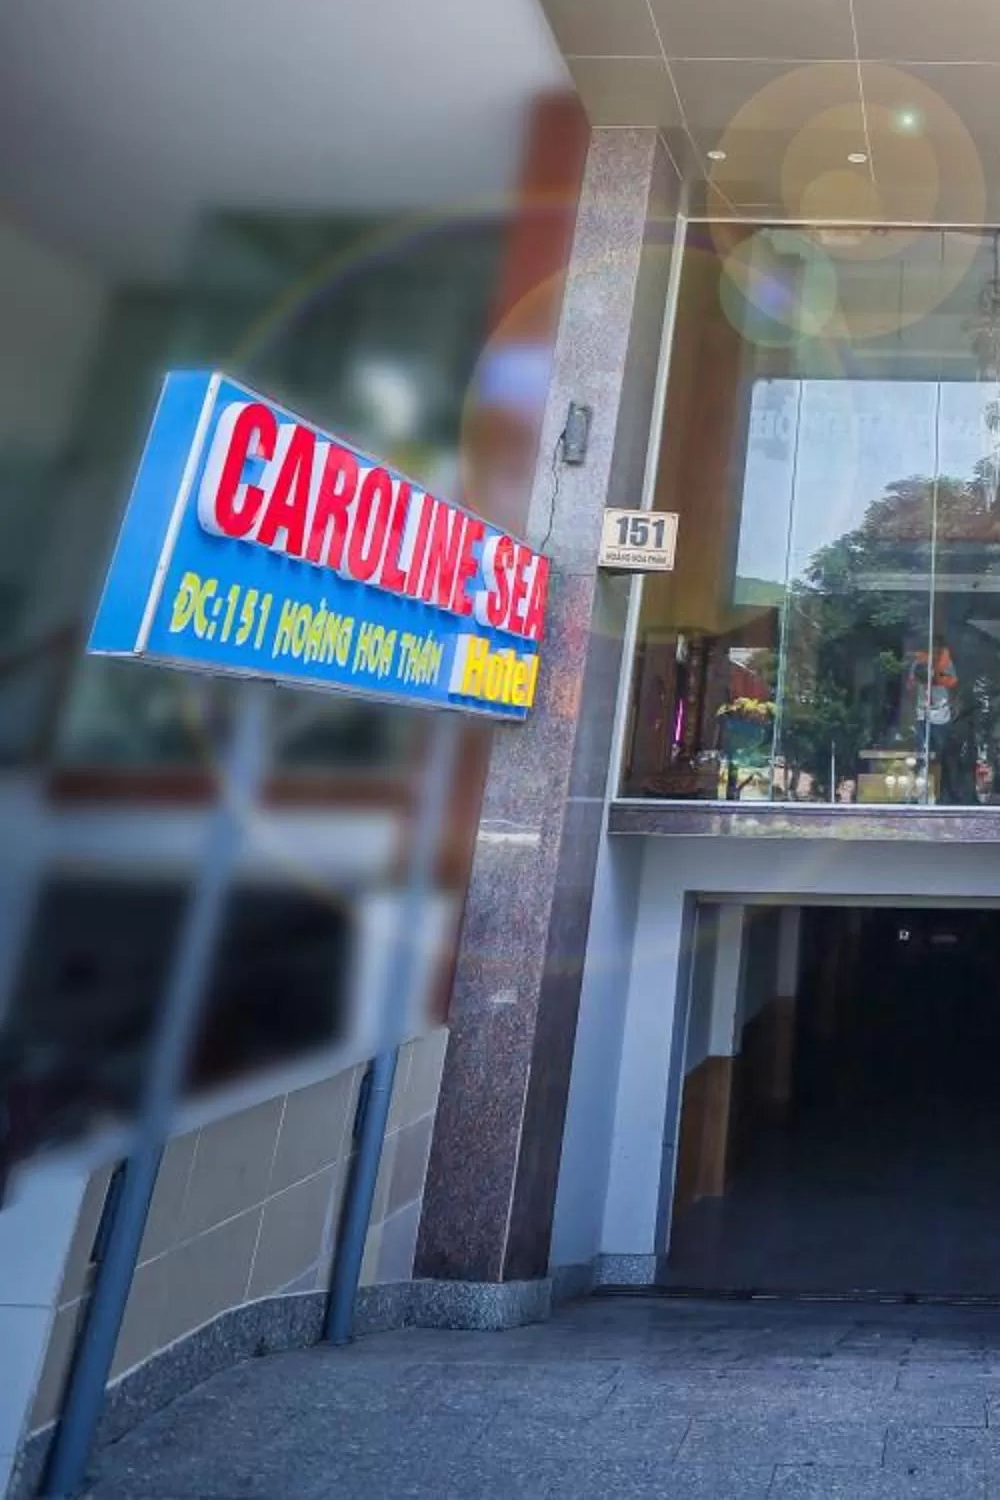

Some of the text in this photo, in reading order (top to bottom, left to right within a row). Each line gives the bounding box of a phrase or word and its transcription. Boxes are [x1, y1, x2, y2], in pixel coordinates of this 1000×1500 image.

[204, 402, 549, 641] CAROLINE SEA
[616, 516, 665, 549] 151
[352, 620, 398, 680] HOA
[458, 633, 540, 708] Hotel
